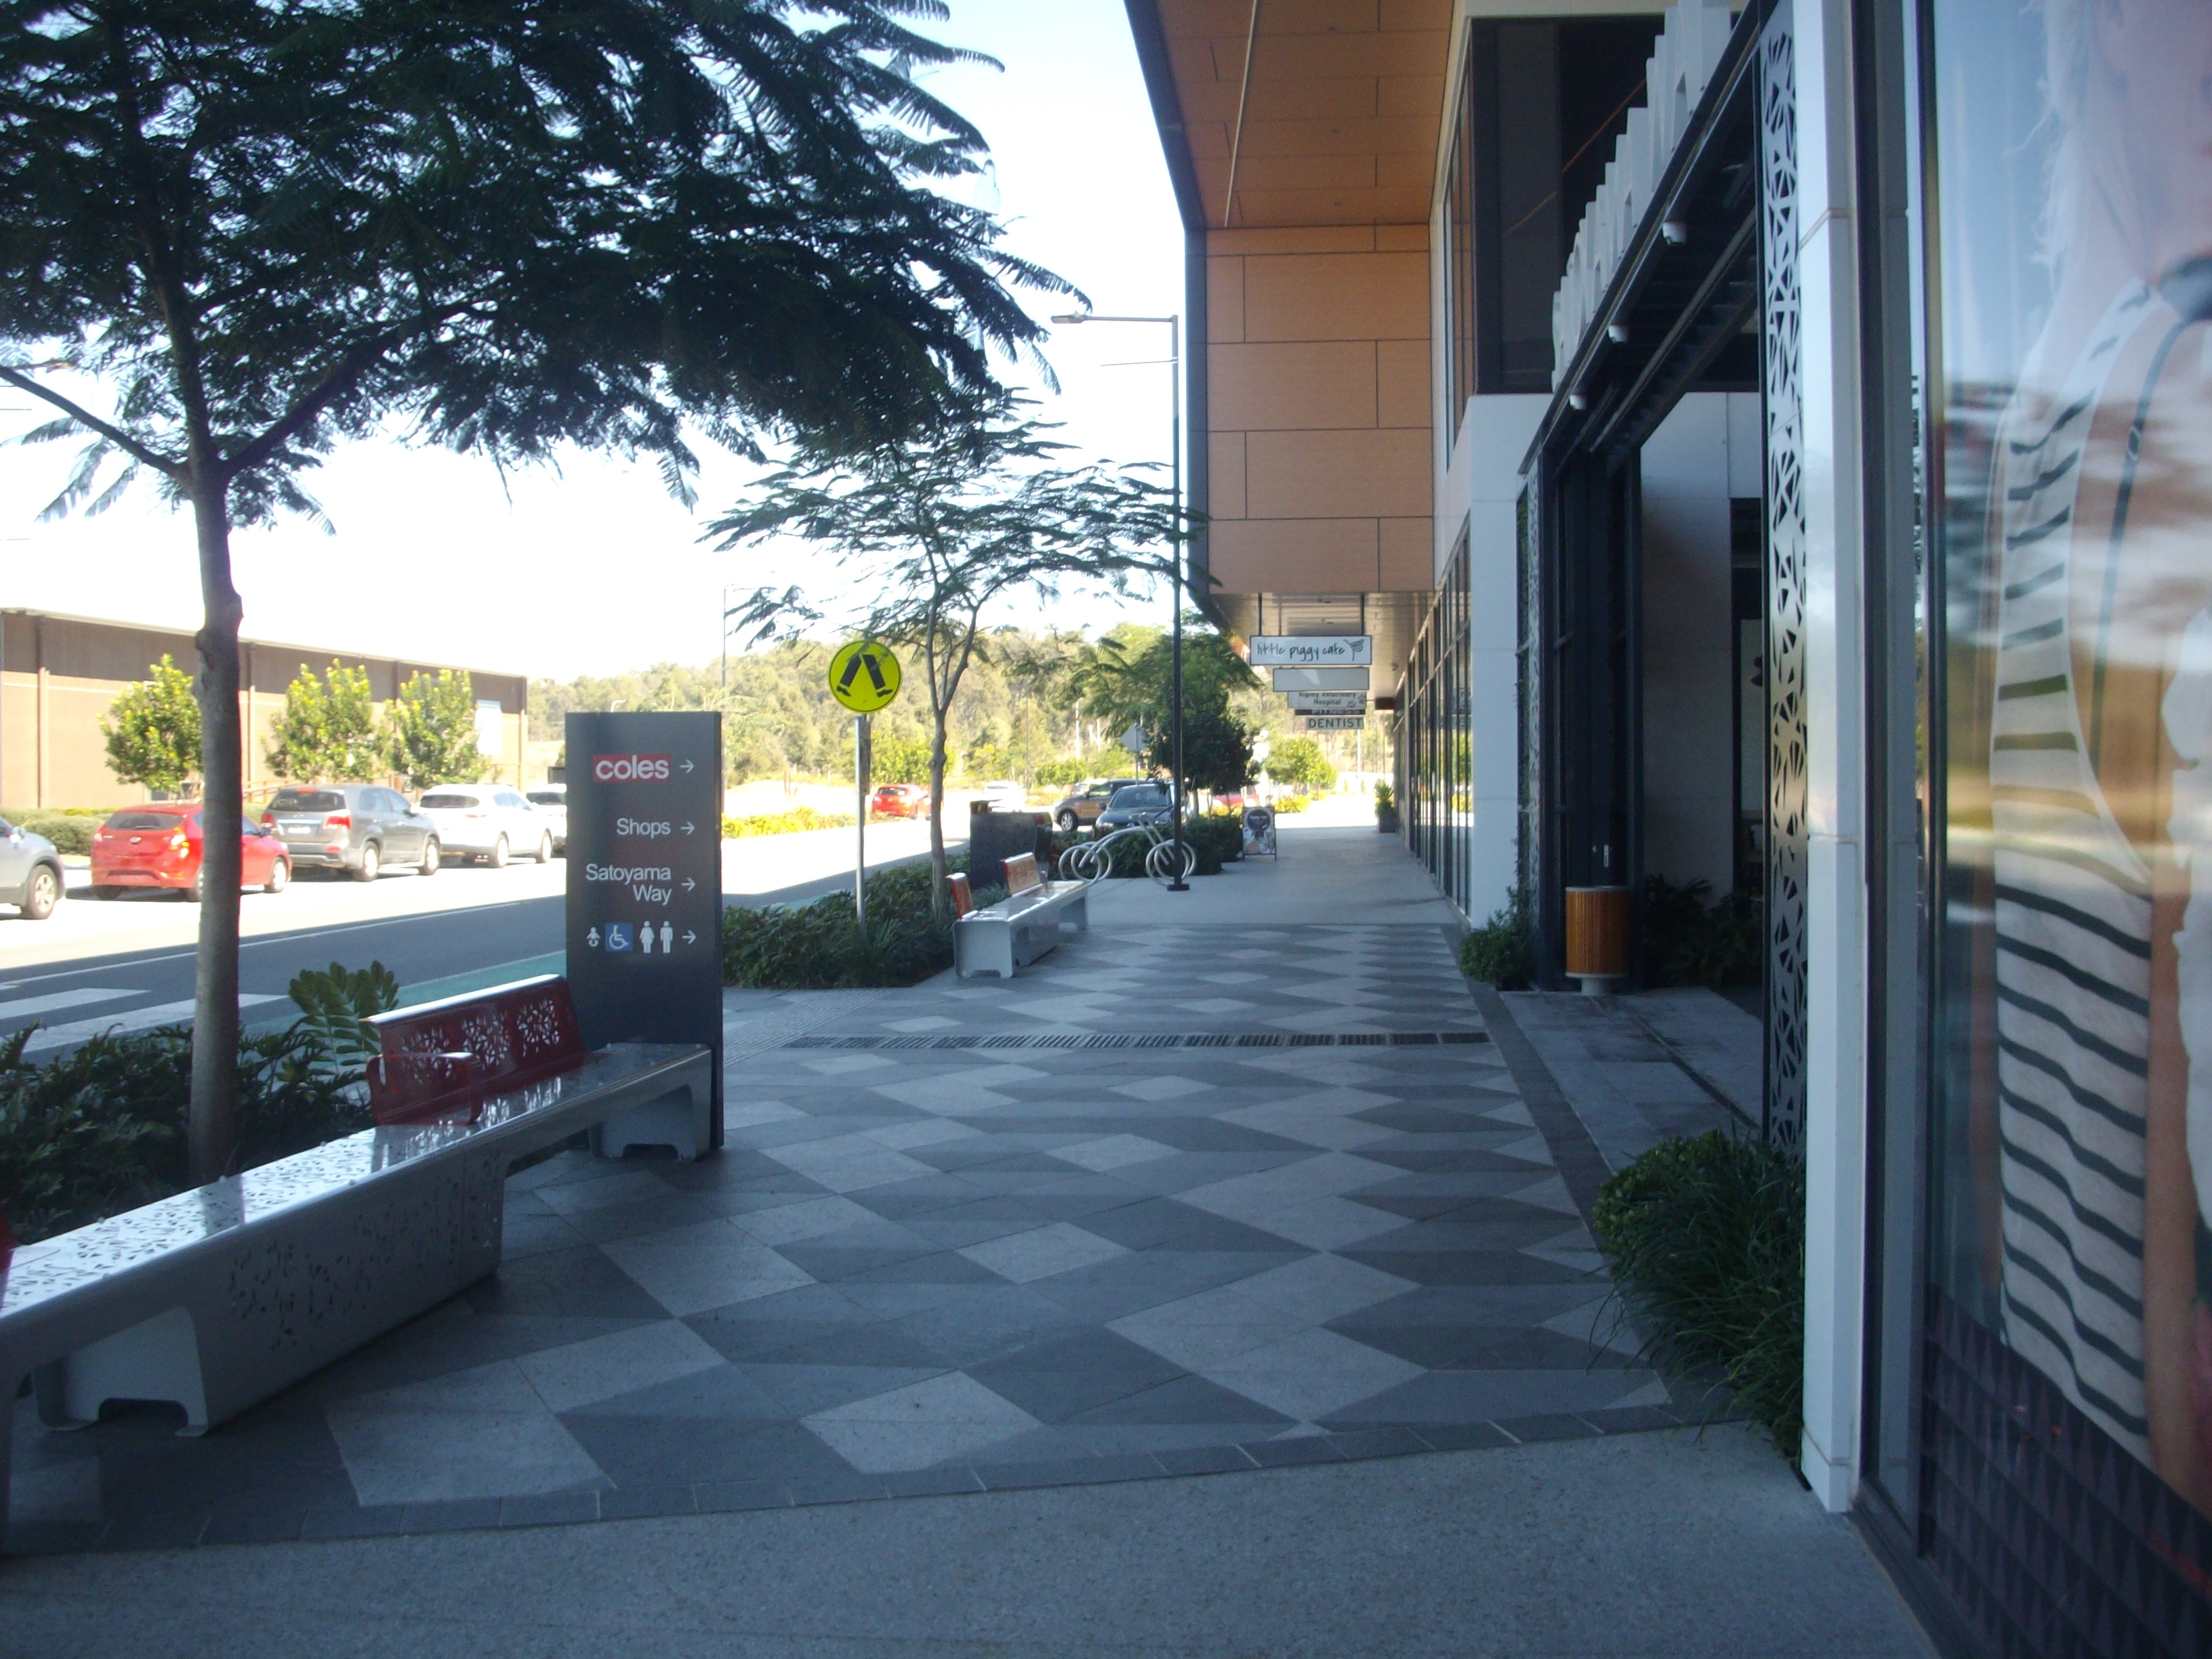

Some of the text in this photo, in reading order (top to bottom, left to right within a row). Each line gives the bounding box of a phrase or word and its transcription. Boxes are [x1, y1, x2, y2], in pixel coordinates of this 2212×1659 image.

[1257, 642, 1285, 655] little
[1289, 646, 1319, 661] piggy
[1309, 718, 1361, 728] DENTIST
[595, 754, 670, 780] coles
[616, 817, 671, 839] Shops
[586, 863, 672, 885] Satoyama
[633, 884, 672, 905] Way
